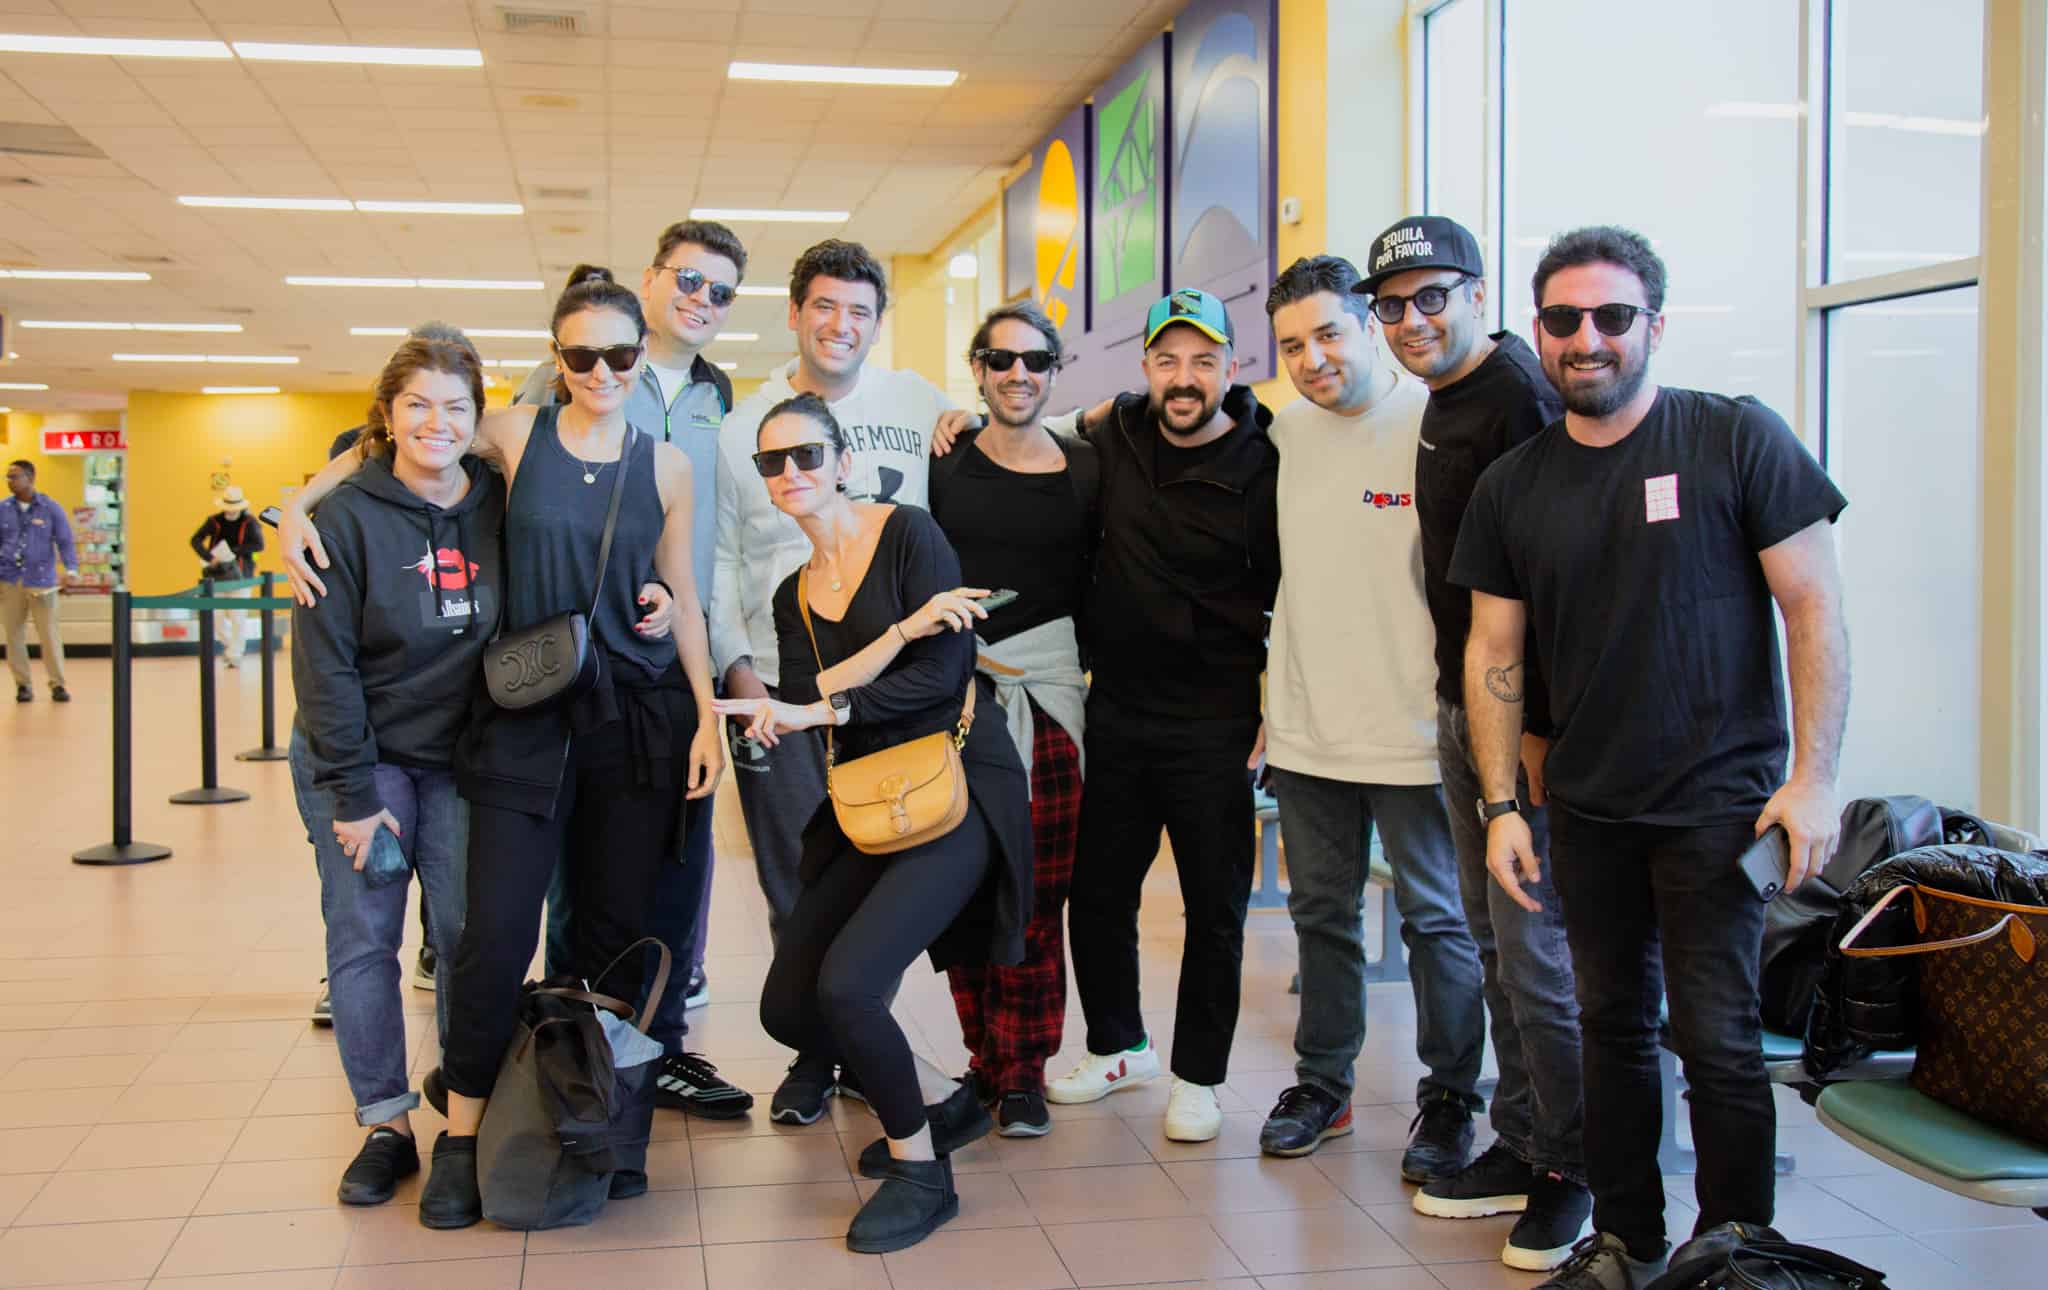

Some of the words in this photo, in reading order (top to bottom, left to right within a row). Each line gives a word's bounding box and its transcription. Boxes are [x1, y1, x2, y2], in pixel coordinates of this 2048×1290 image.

[1383, 226, 1424, 251] TEQUILA
[1395, 241, 1433, 259] FAVOR
[61, 434, 84, 449] LA
